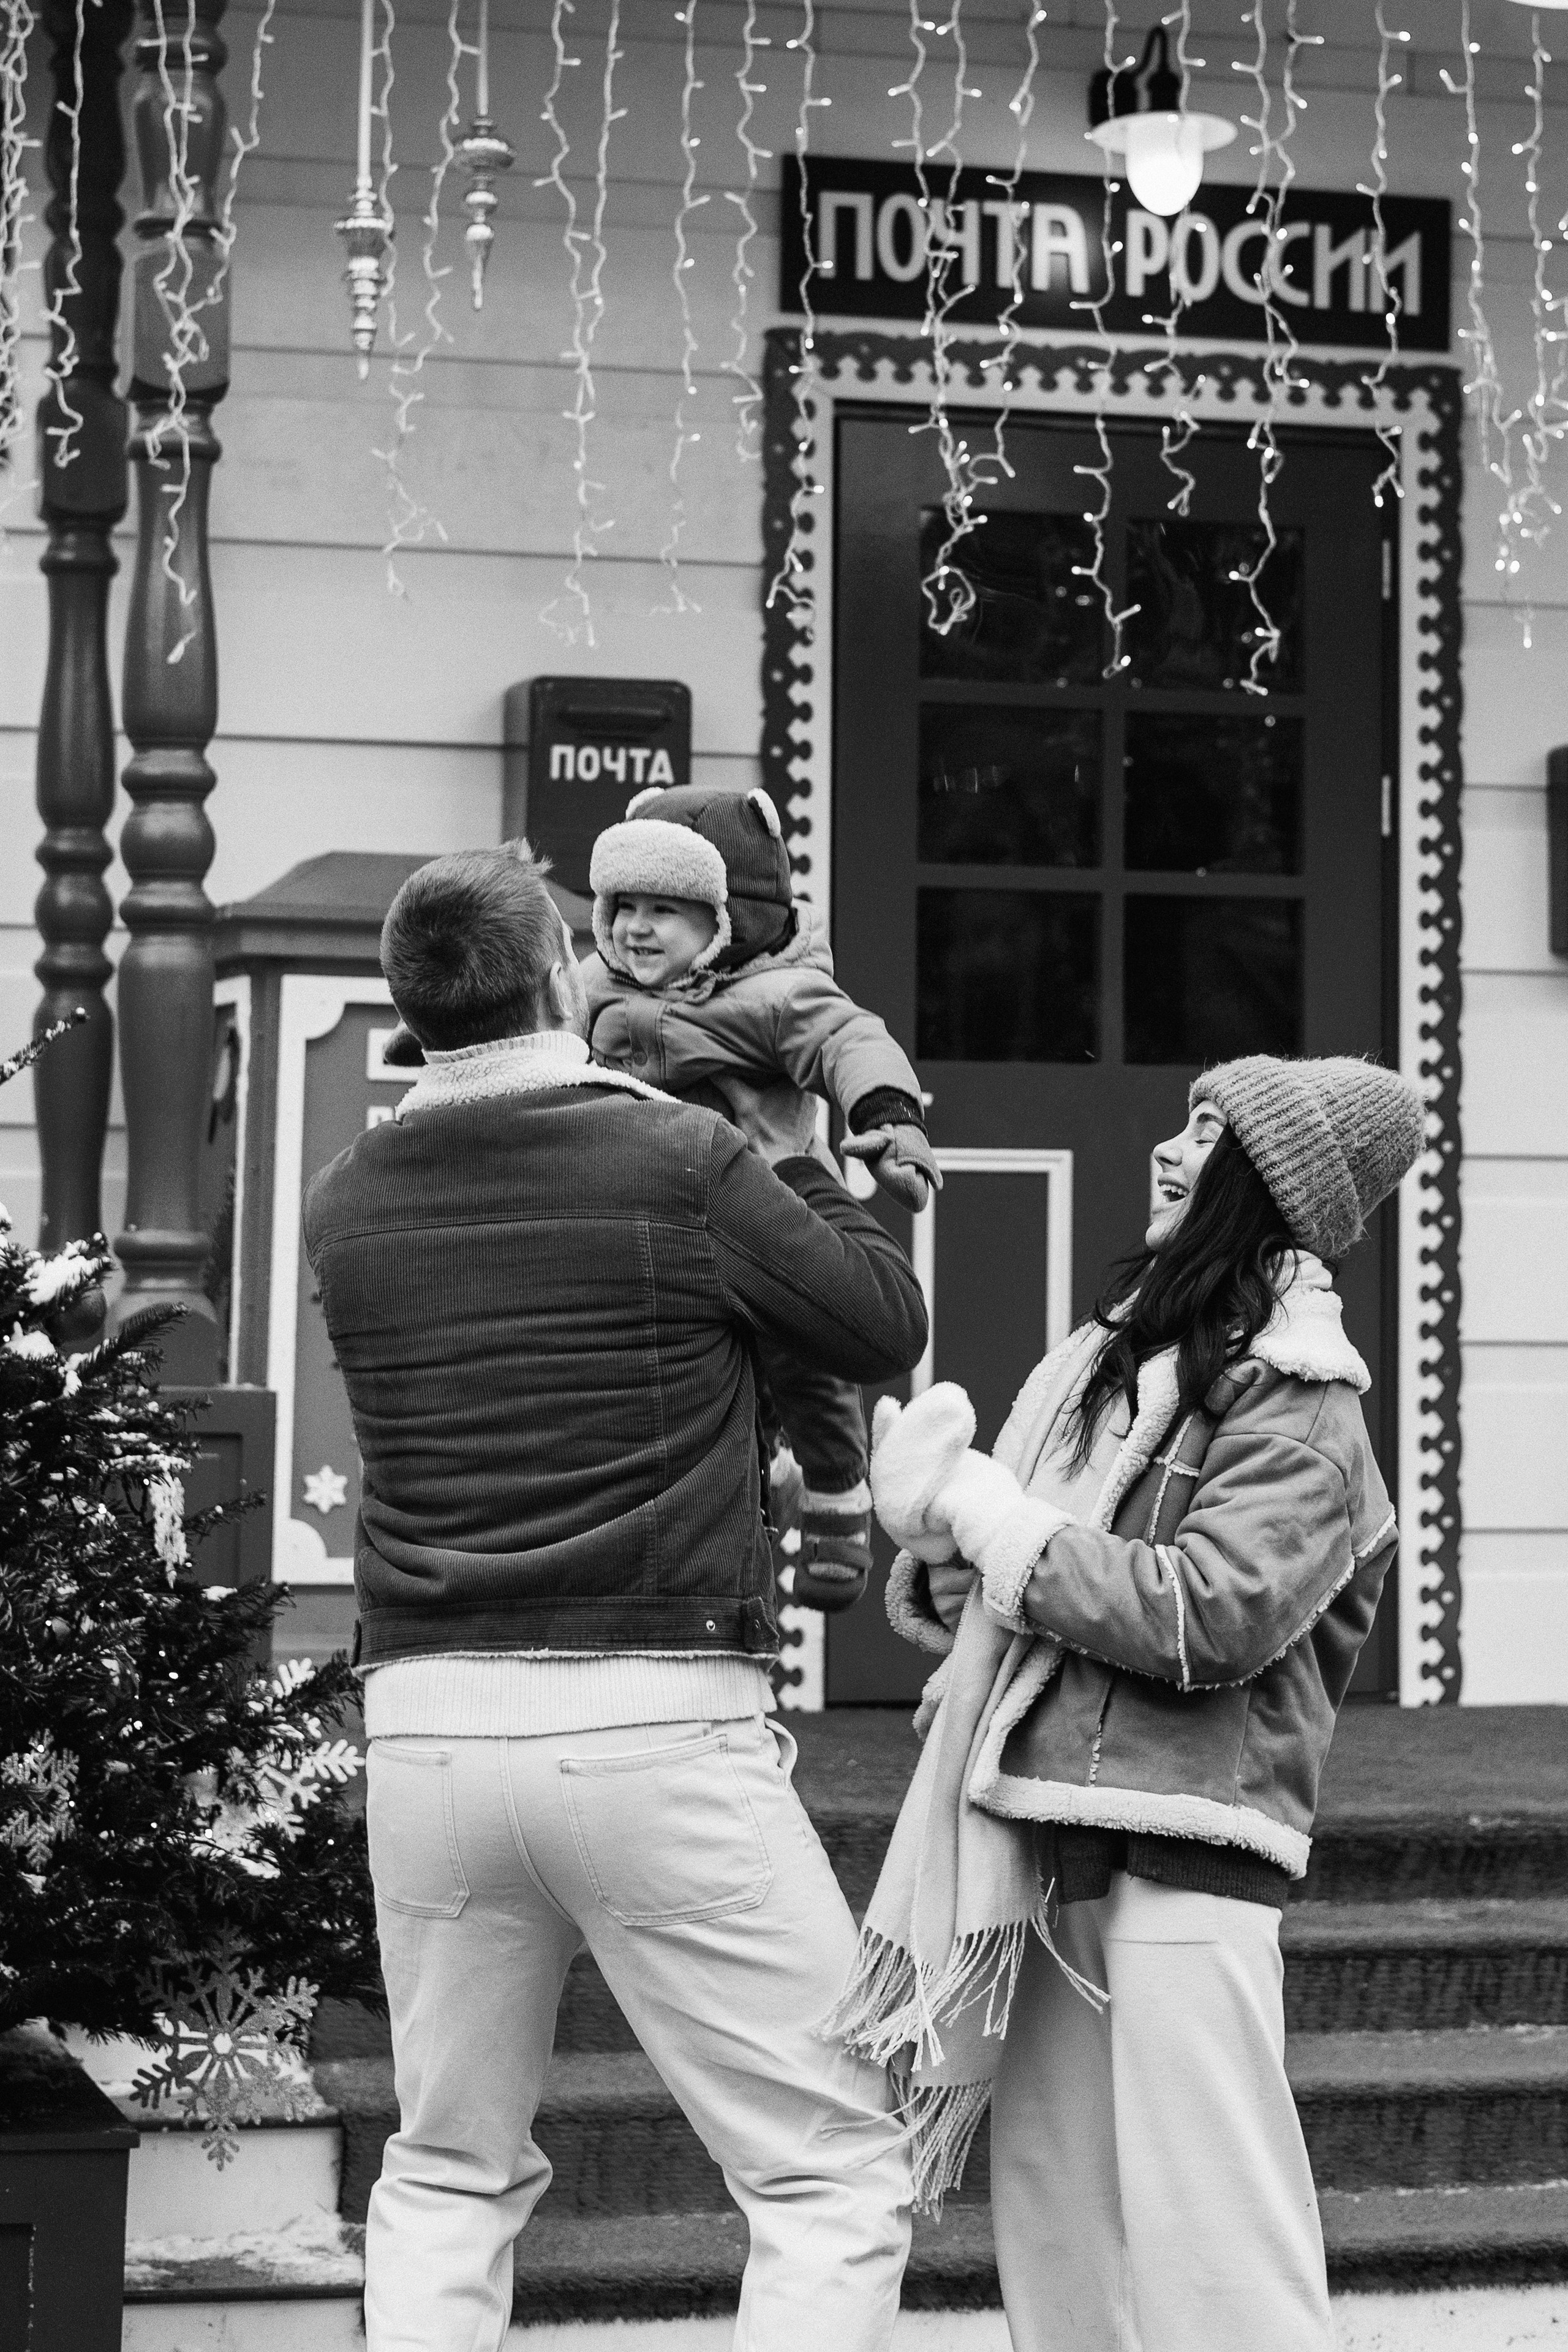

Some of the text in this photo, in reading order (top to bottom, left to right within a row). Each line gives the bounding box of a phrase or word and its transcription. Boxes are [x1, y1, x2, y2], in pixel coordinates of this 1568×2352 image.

[818, 190, 1422, 317] ПОЧТА РОССИИ
[550, 744, 674, 785] ПОЧТА
